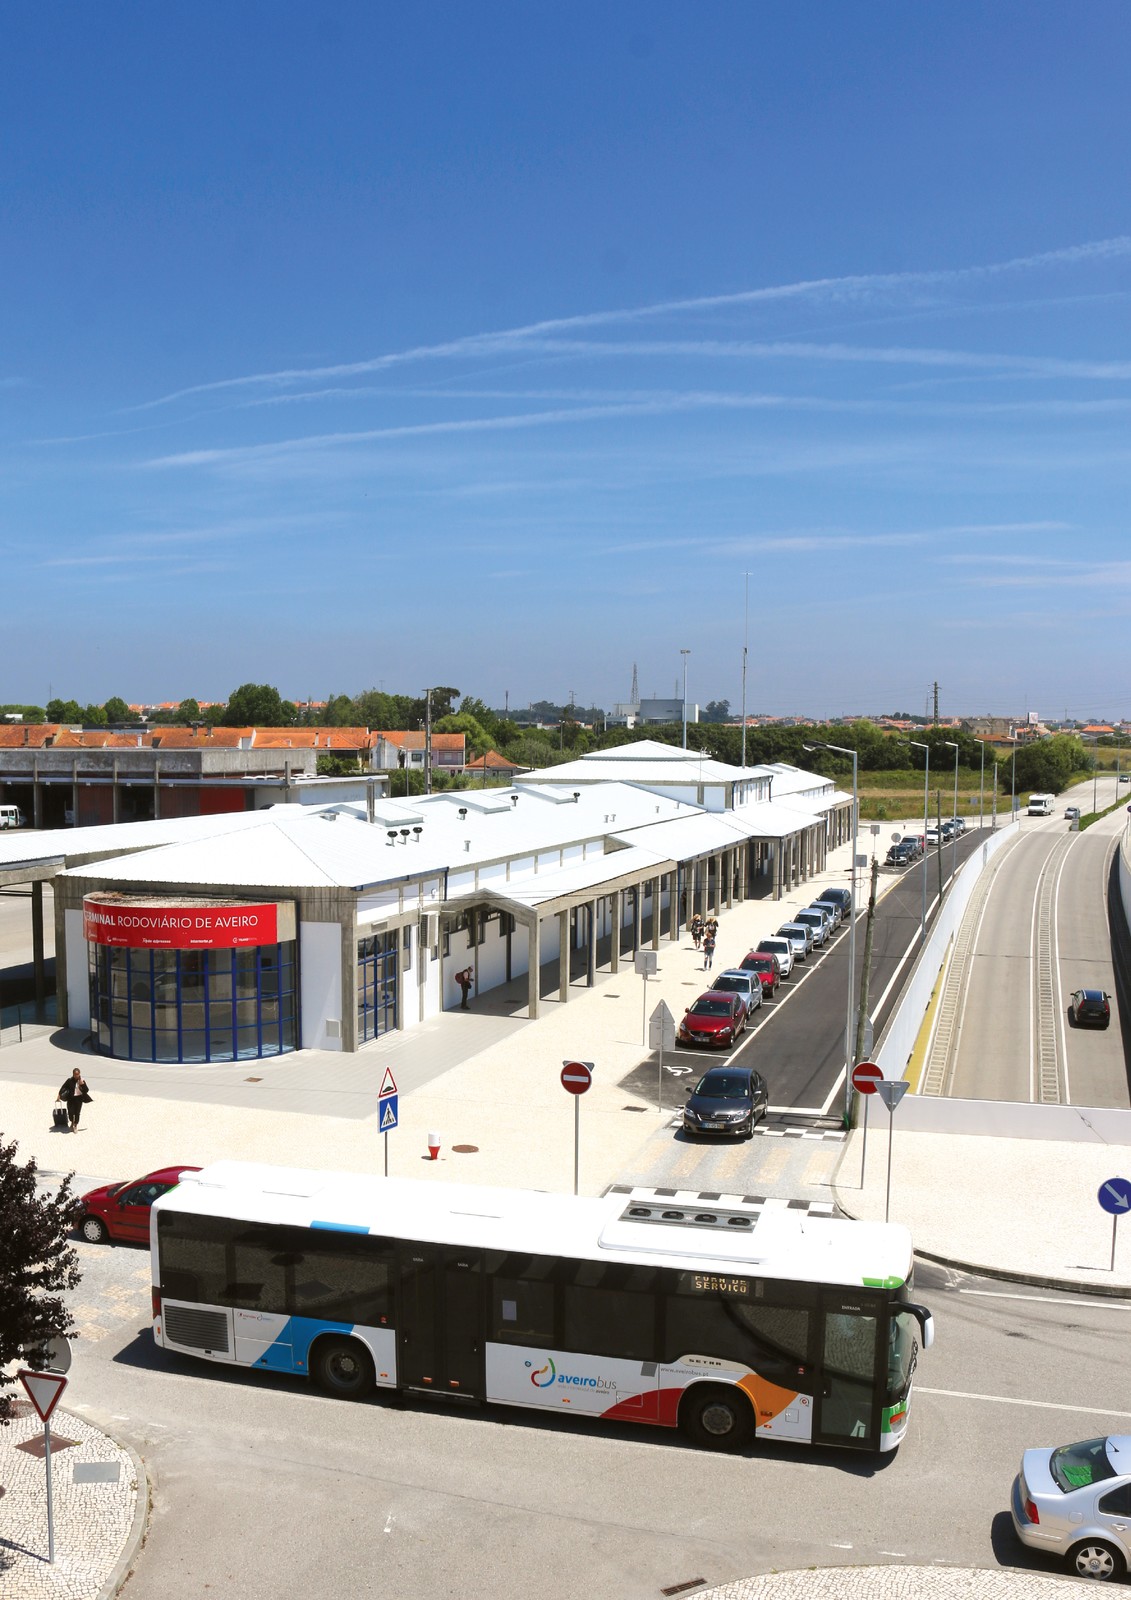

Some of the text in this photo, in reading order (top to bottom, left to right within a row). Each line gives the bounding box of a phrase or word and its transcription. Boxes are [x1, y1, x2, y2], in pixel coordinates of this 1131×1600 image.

[117, 915, 192, 929] RODOVIÁRIO
[195, 917, 212, 928] DE
[214, 915, 259, 928] AVEIRO
[557, 1374, 617, 1390] aveirobus
